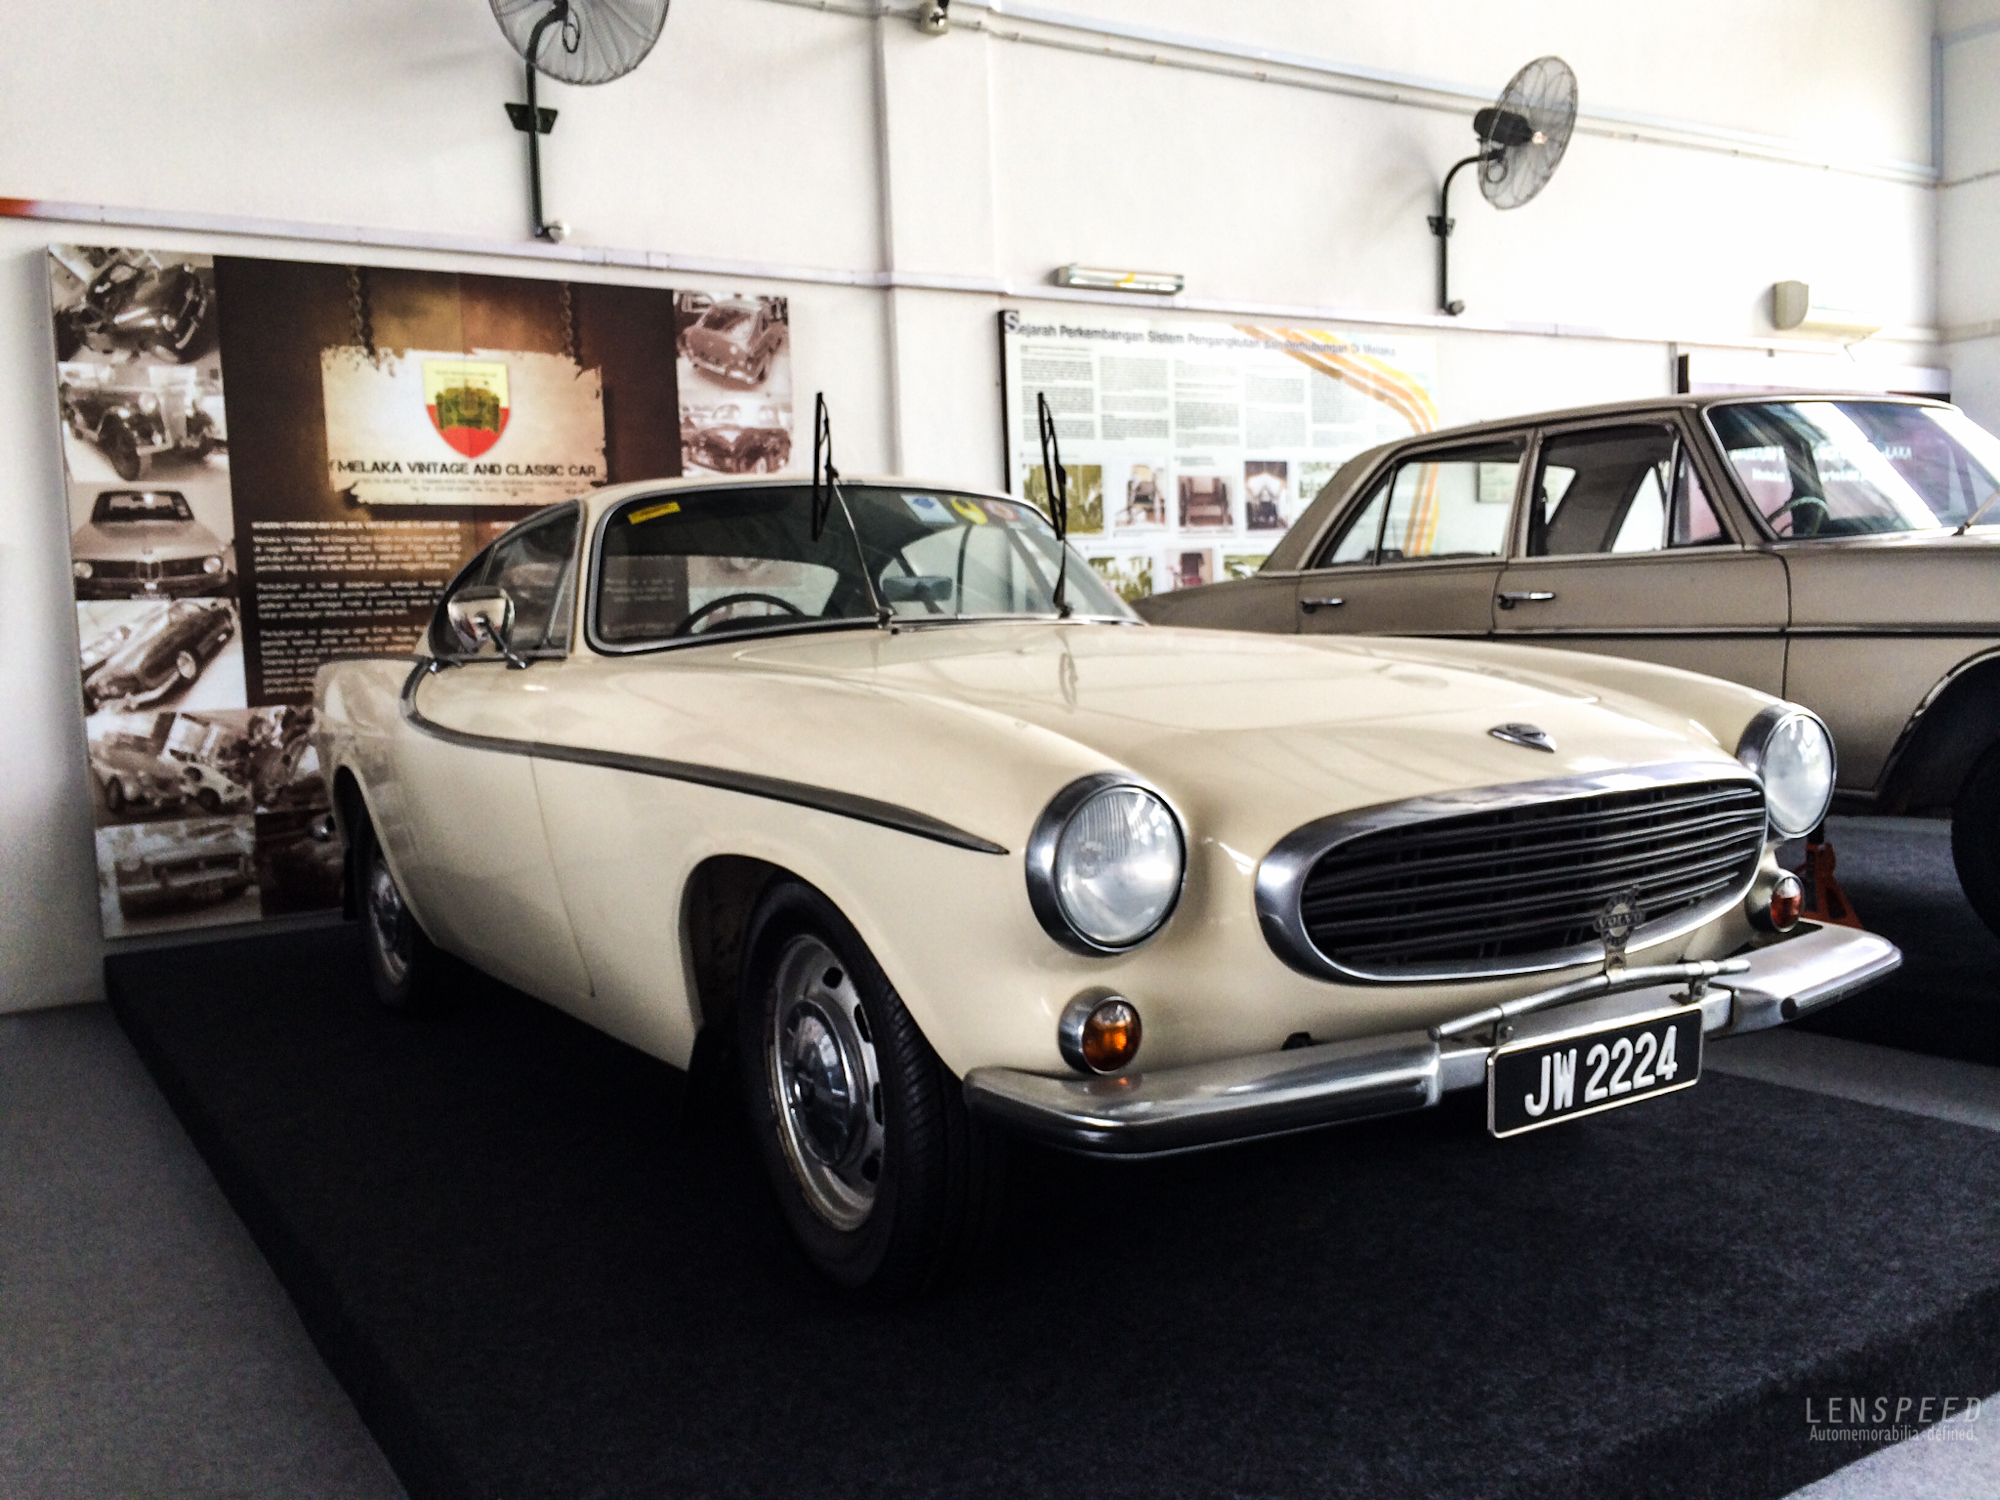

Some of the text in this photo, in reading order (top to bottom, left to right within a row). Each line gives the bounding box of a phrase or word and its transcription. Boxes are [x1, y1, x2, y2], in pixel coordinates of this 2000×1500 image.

[1060, 325, 1145, 343] Perkembangan
[1148, 330, 1183, 345] Sistem
[338, 460, 597, 477] MELAKA VINTAGE AND CLASSIC CAR
[1524, 1025, 1678, 1116] JW 2224
